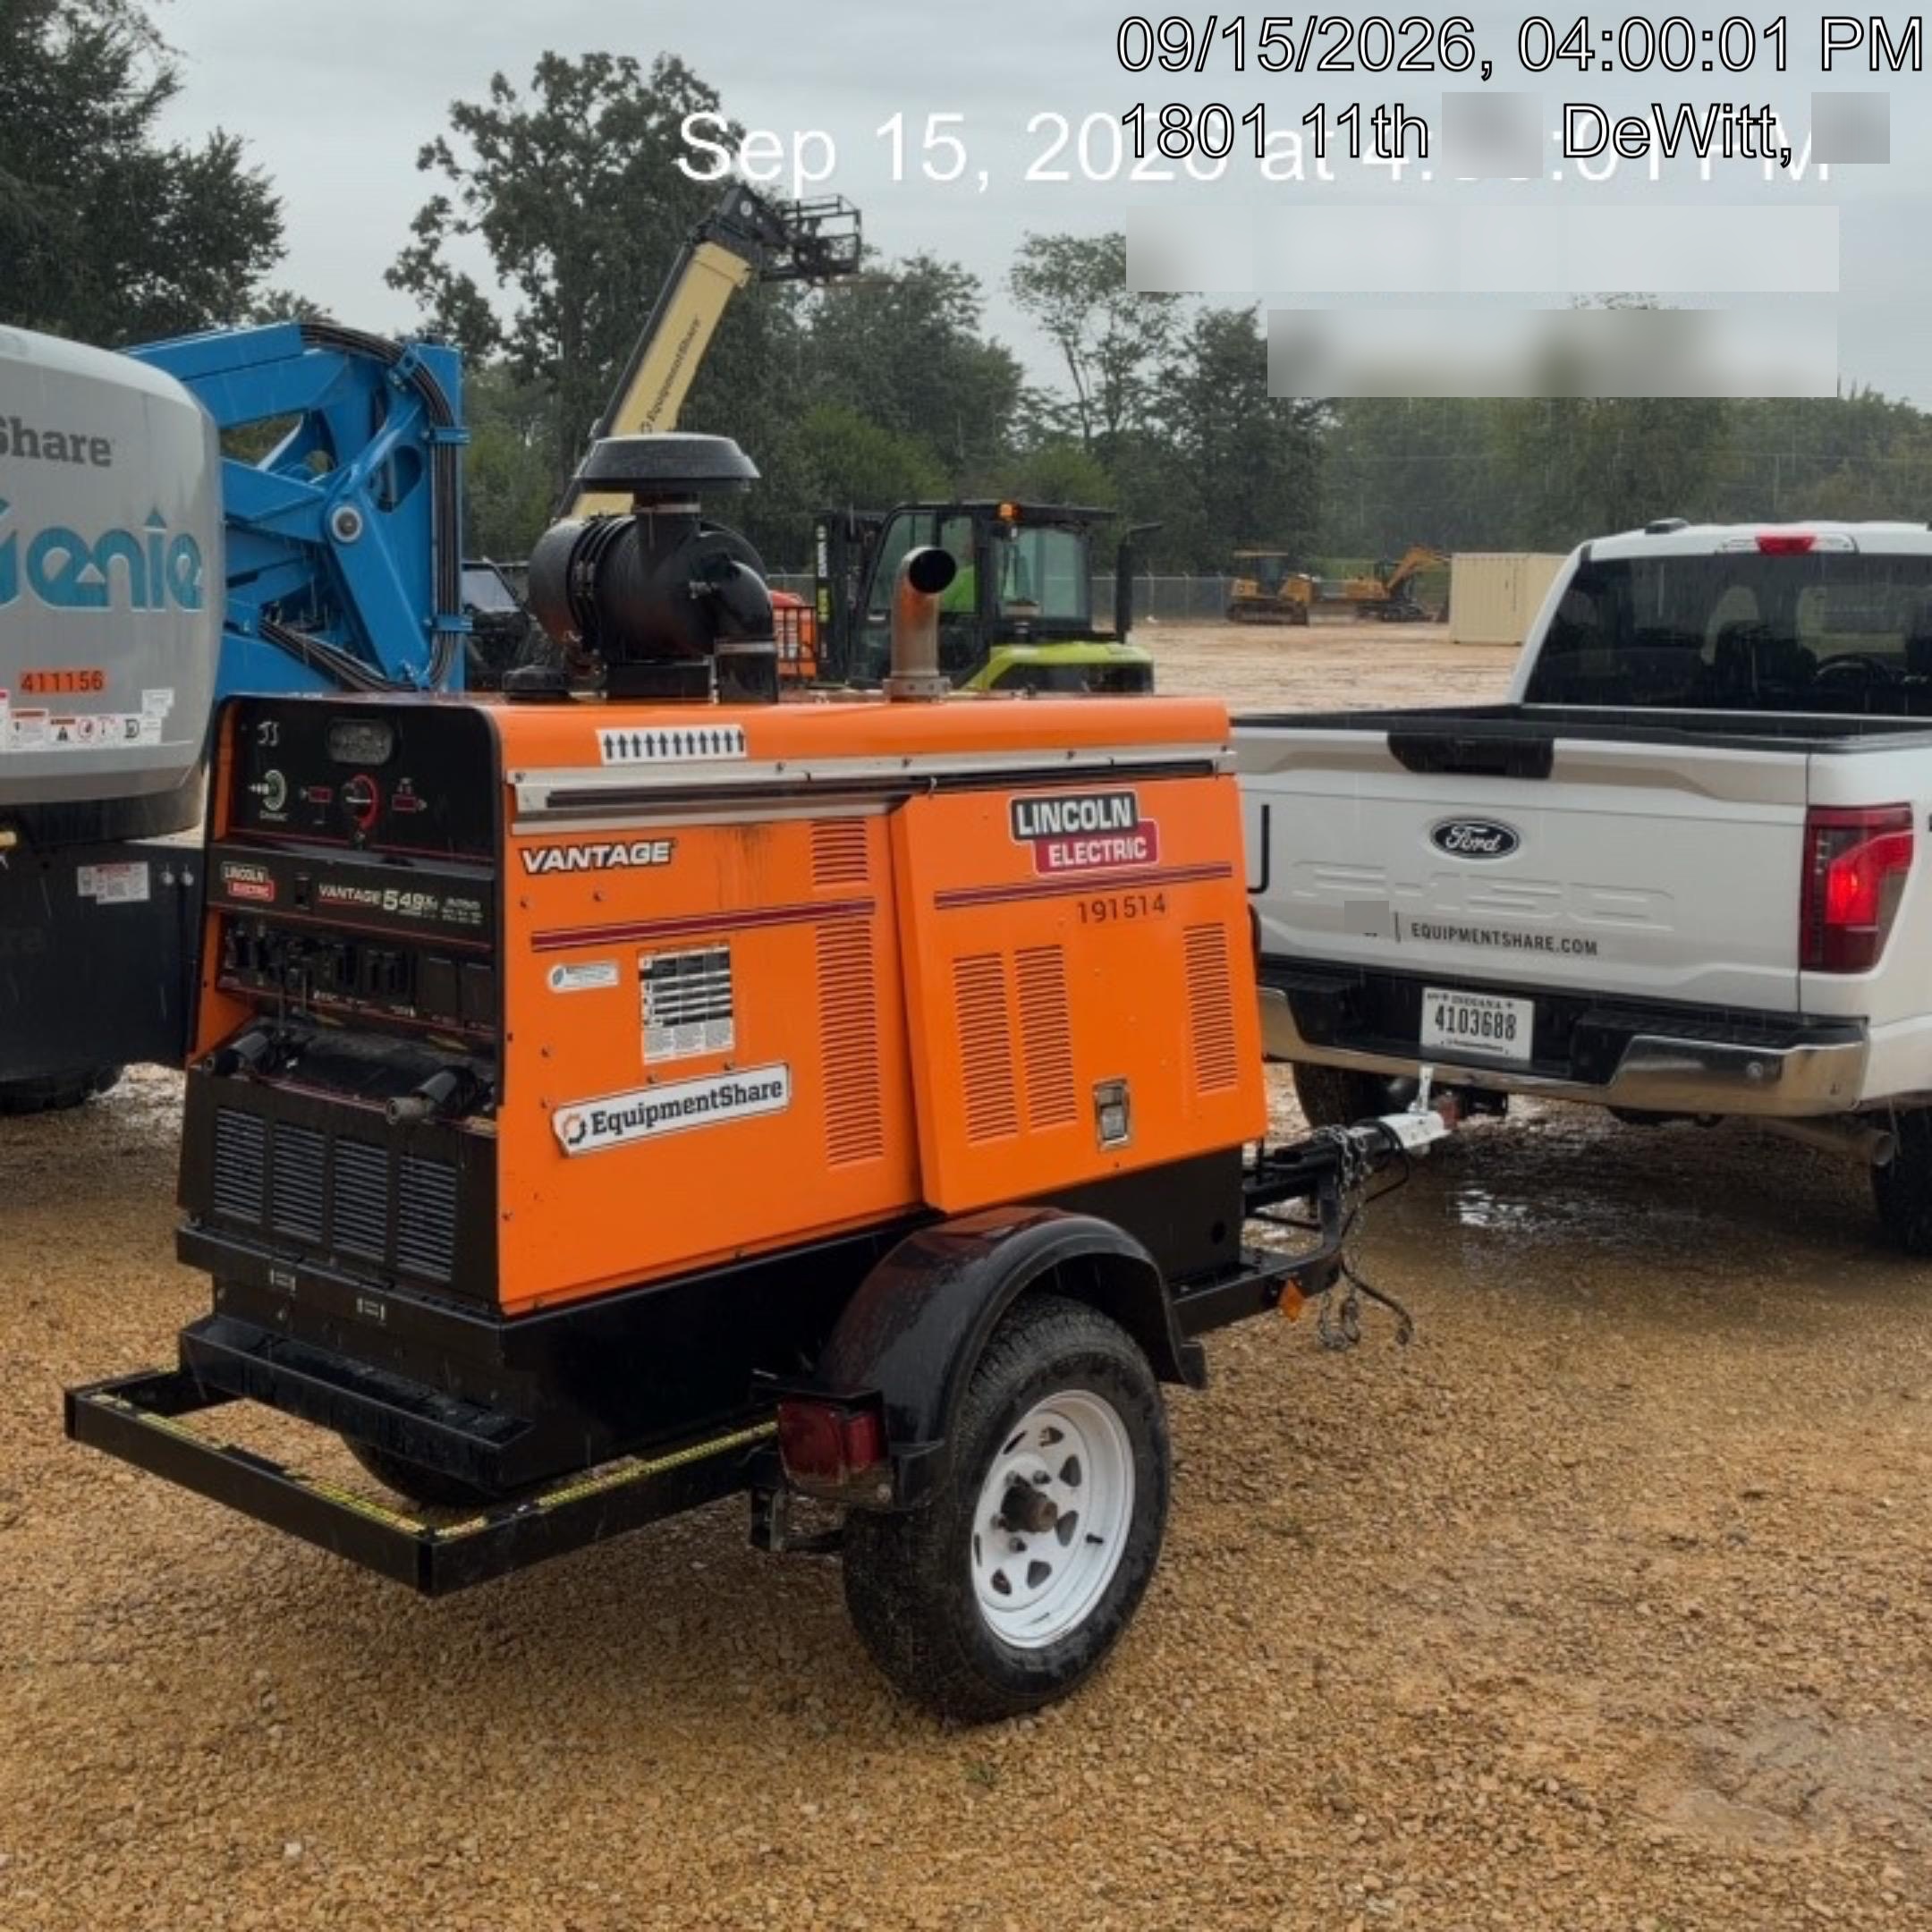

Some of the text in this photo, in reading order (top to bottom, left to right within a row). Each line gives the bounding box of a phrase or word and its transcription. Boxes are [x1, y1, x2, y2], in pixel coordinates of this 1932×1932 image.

[21, 670, 105, 692] 411156
[1016, 796, 1132, 836] LINCOLN
[1047, 836, 1148, 869] ELECTRIC
[1445, 824, 1503, 852] Ford
[521, 839, 673, 876] VANTAGE
[1076, 894, 1167, 924] 191514
[1411, 921, 1598, 956] EQUIPMENTSHARE.COM
[1434, 1004, 1518, 1042] 4103688
[590, 1079, 783, 1136] EquipmentShare
